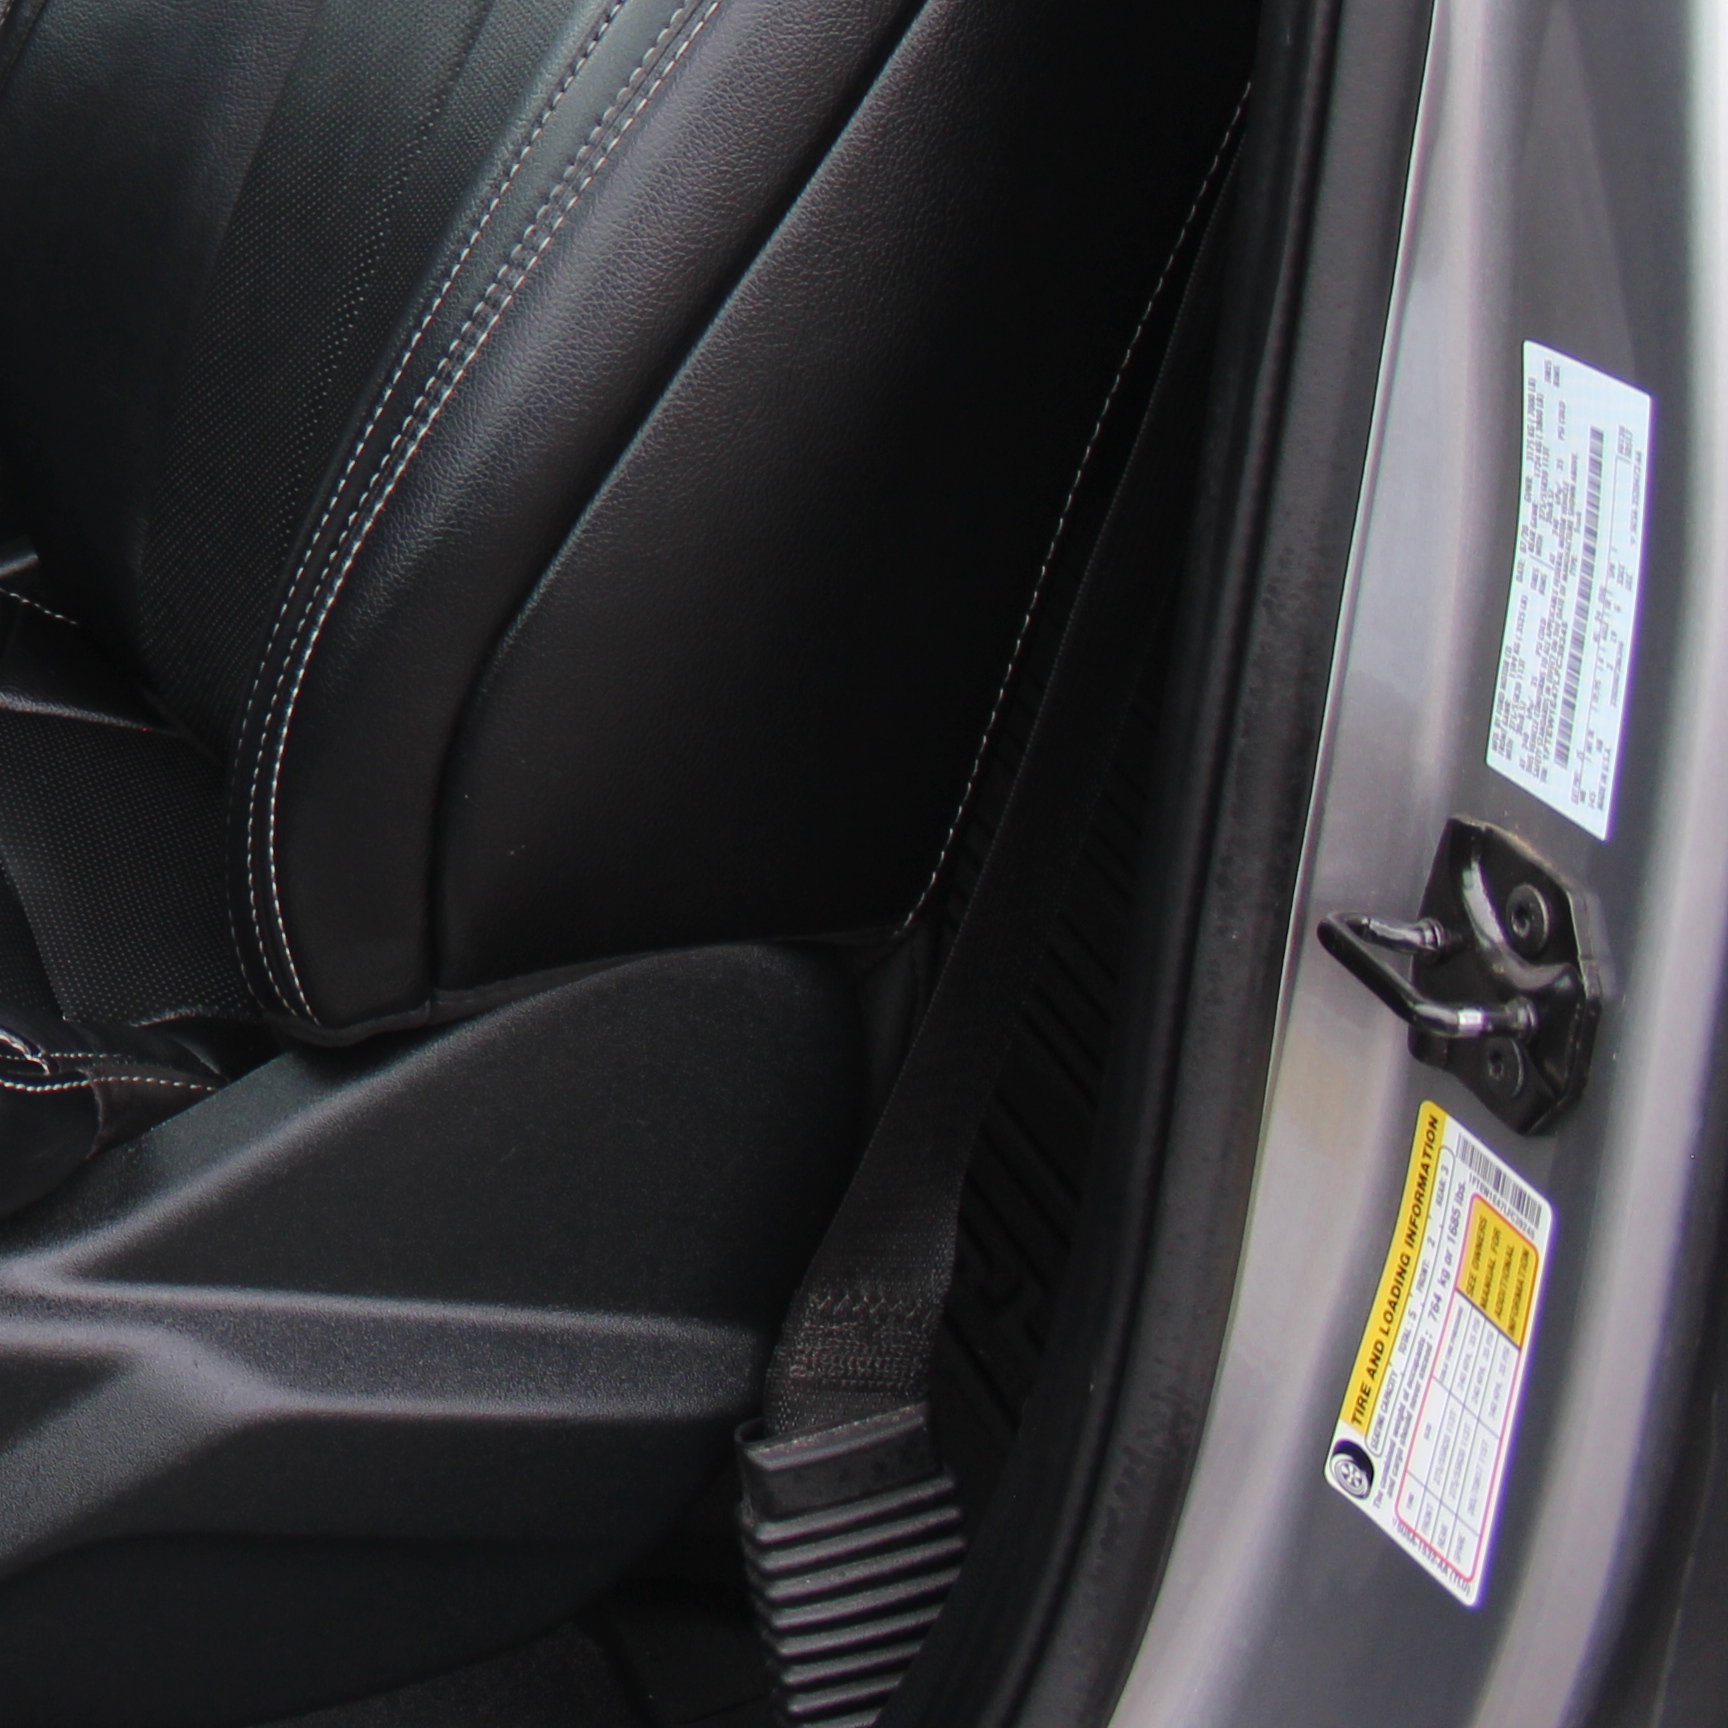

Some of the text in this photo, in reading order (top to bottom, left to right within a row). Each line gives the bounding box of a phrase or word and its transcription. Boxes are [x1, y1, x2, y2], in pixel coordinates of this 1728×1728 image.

[1444, 1204, 1461, 1245] 1685
[1350, 1113, 1441, 1430] TIRE AND LOADING INFORMATION
[1442, 1246, 1452, 1266] or
[1436, 1265, 1450, 1289] kg
[1427, 1290, 1441, 1322] 764
